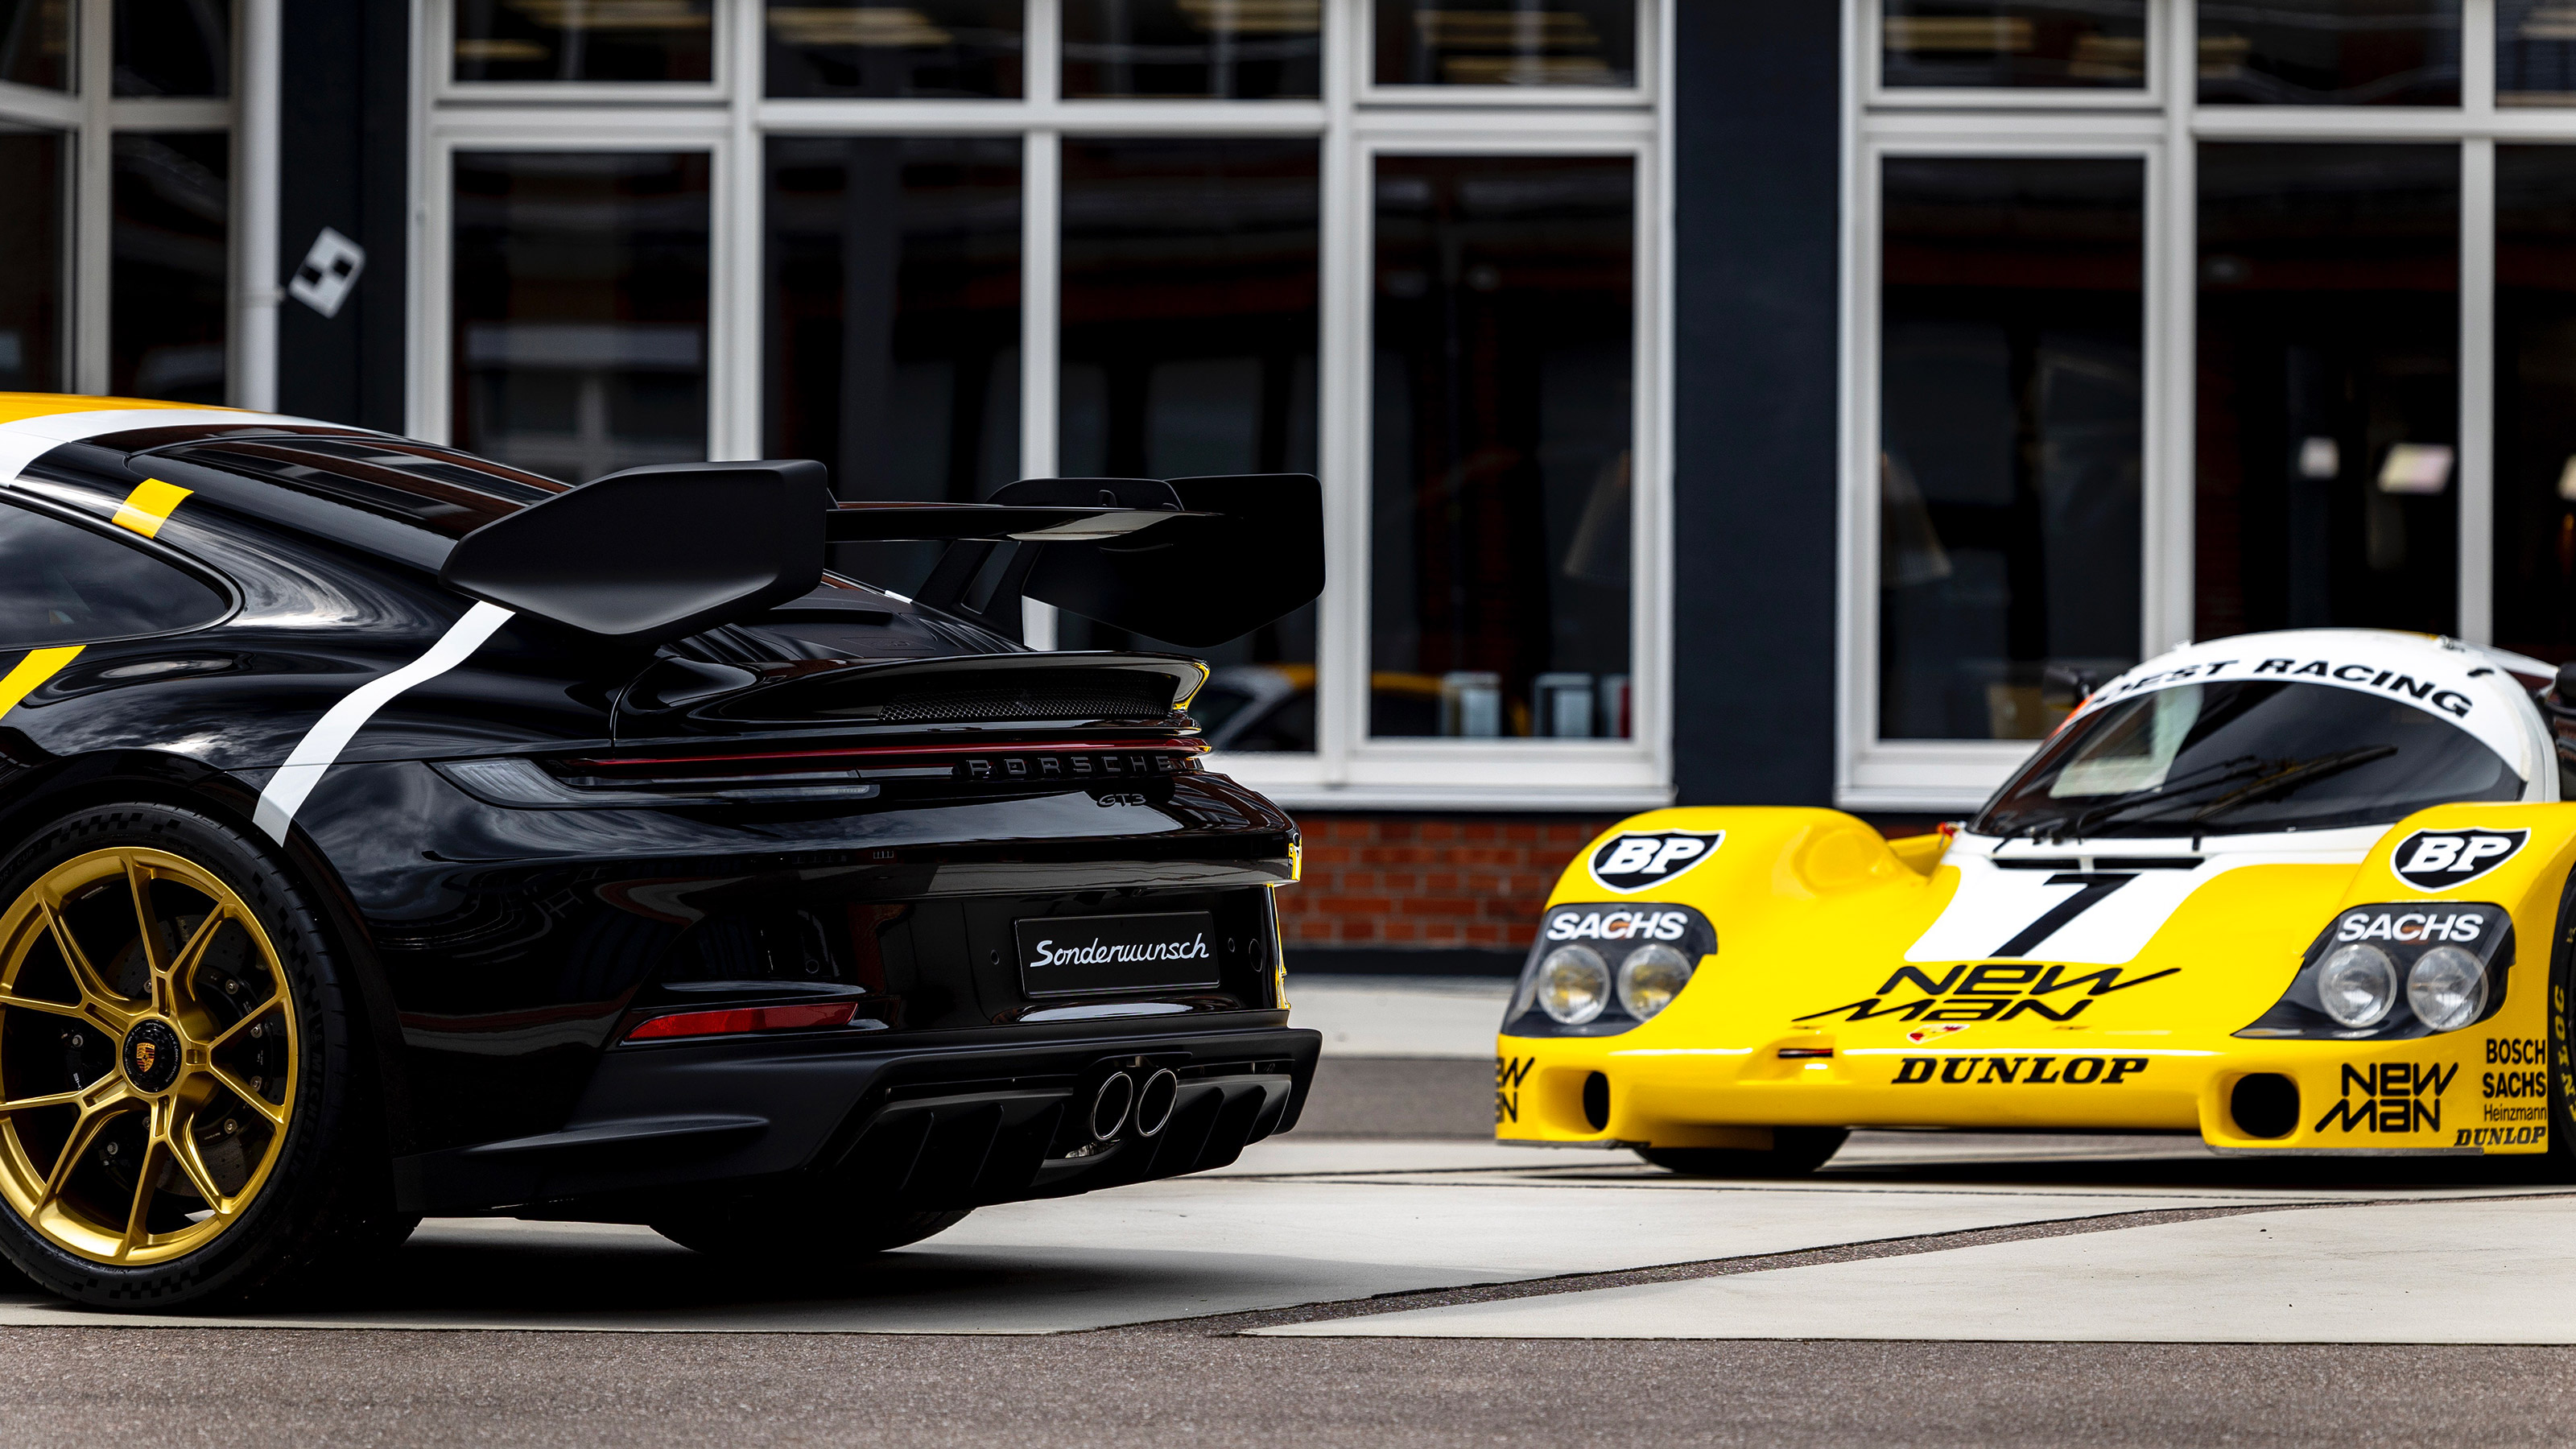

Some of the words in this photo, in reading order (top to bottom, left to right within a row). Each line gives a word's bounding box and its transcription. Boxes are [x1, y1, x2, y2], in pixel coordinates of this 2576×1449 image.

[2093, 659, 2240, 704] EST
[2253, 658, 2475, 719] RACING
[966, 755, 1172, 775] PORSCHE
[1096, 793, 1146, 808] GT3
[1596, 836, 1707, 875] BP
[2400, 835, 2512, 873] BP
[1546, 910, 1689, 942] SACHS
[1988, 873, 2142, 958] 7
[2338, 912, 2484, 943] SACHS
[1030, 932, 1209, 968] Sonderwunsch
[2485, 1038, 2546, 1065] BOSCH
[1890, 1057, 2149, 1084] DUNLOP
[2482, 1071, 2547, 1098] SACHS
[2483, 1103, 2547, 1122] Heinzmann
[2454, 1126, 2547, 1147] DUNLOP
